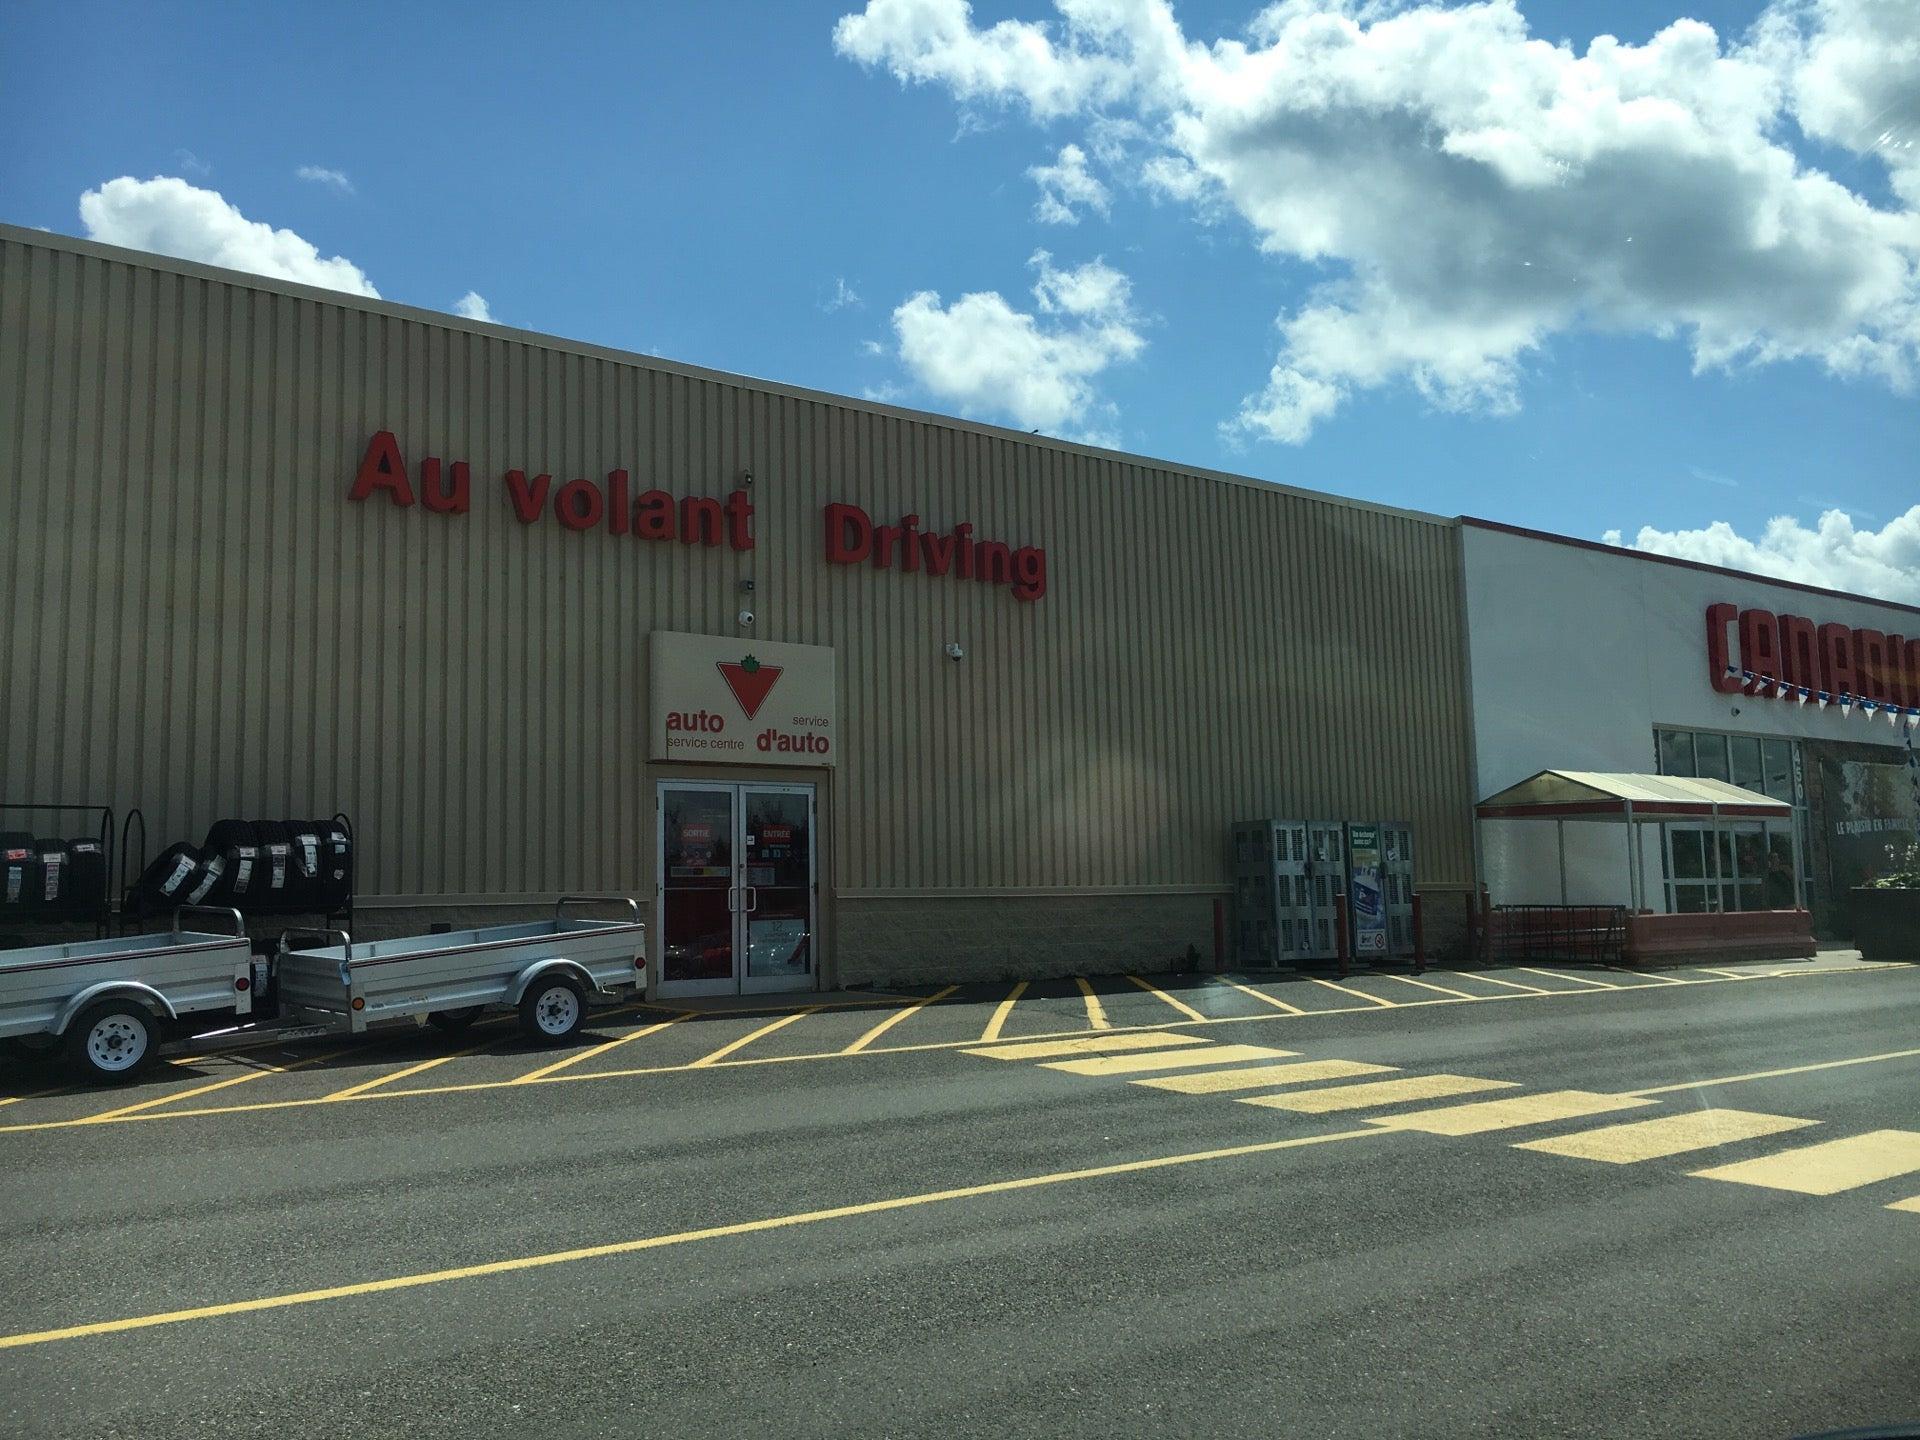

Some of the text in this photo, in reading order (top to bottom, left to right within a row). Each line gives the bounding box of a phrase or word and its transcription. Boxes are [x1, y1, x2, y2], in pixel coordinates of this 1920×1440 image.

[348, 430, 756, 552] Au volant
[824, 502, 1047, 602] Driving
[666, 710, 724, 733] auto
[792, 715, 829, 727] service
[667, 735, 745, 750] service centre
[756, 728, 830, 754] d'auto
[1793, 749, 1804, 800] 450
[1836, 821, 1845, 835] LE
